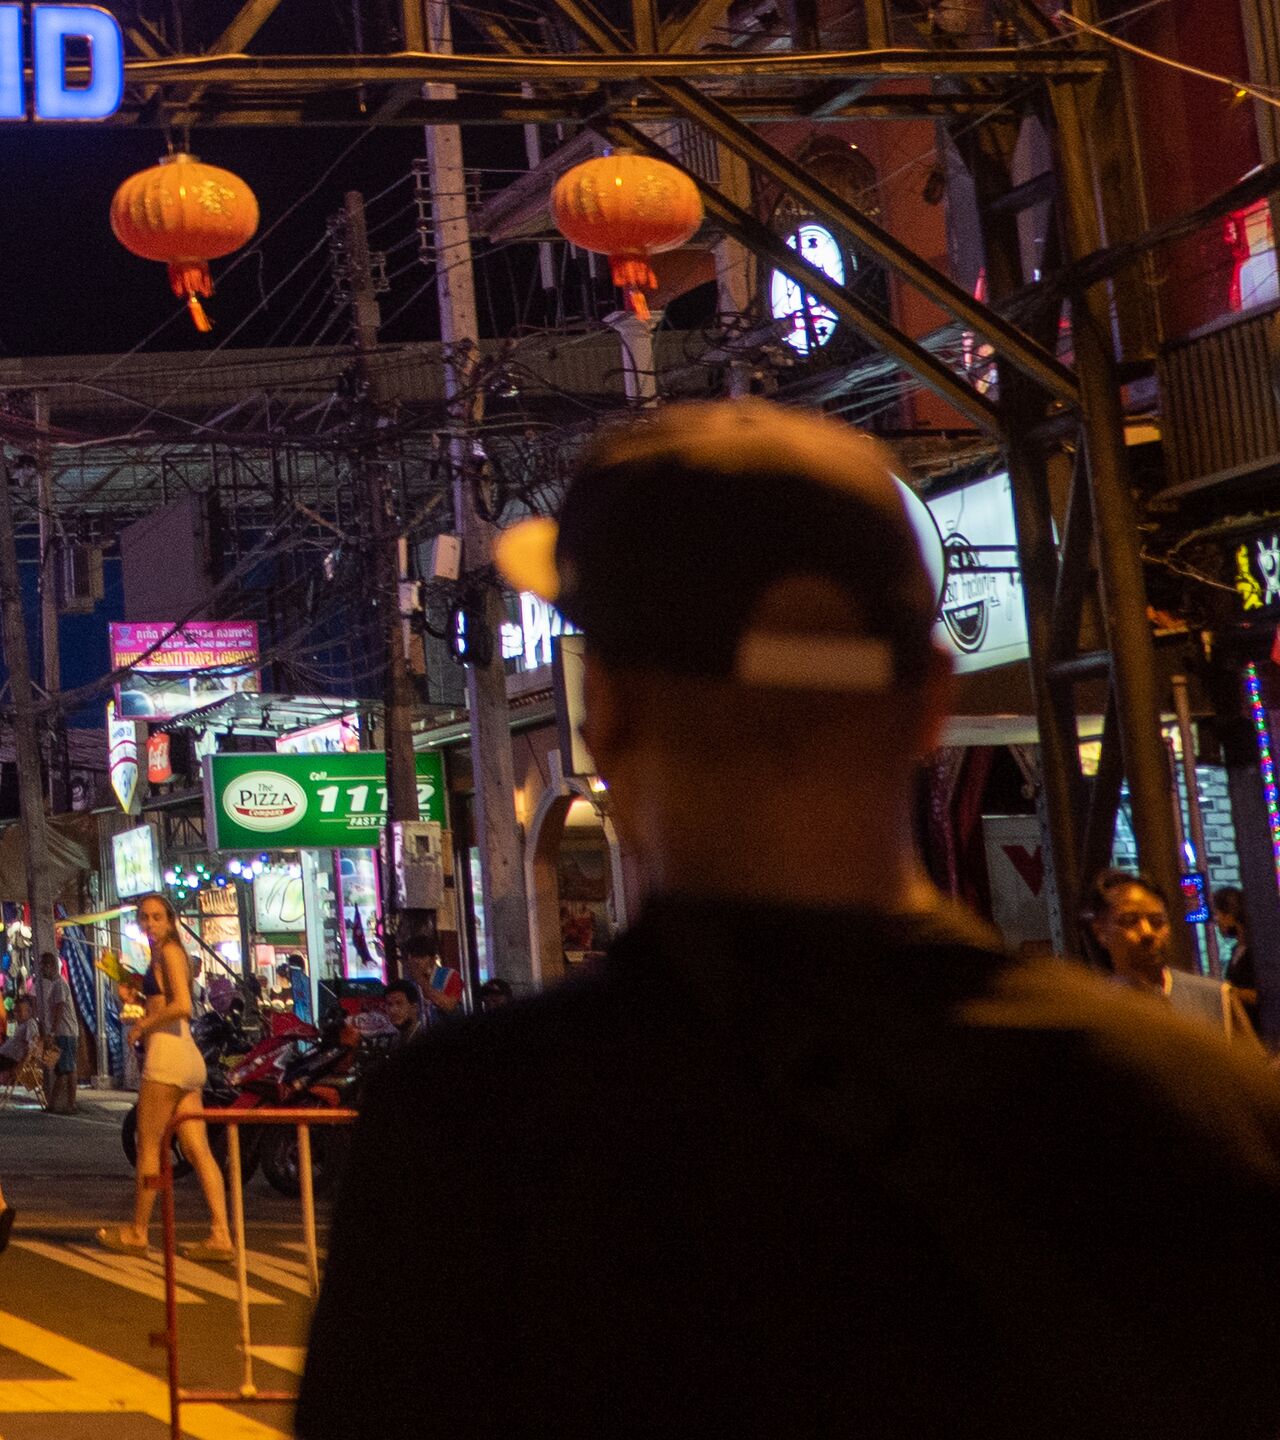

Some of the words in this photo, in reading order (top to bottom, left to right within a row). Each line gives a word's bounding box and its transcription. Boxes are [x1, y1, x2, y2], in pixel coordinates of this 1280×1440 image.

[309, 771, 328, 781] Call
[258, 784, 274, 792] The
[240, 789, 293, 807] PIZZA
[349, 817, 377, 826] FAST
